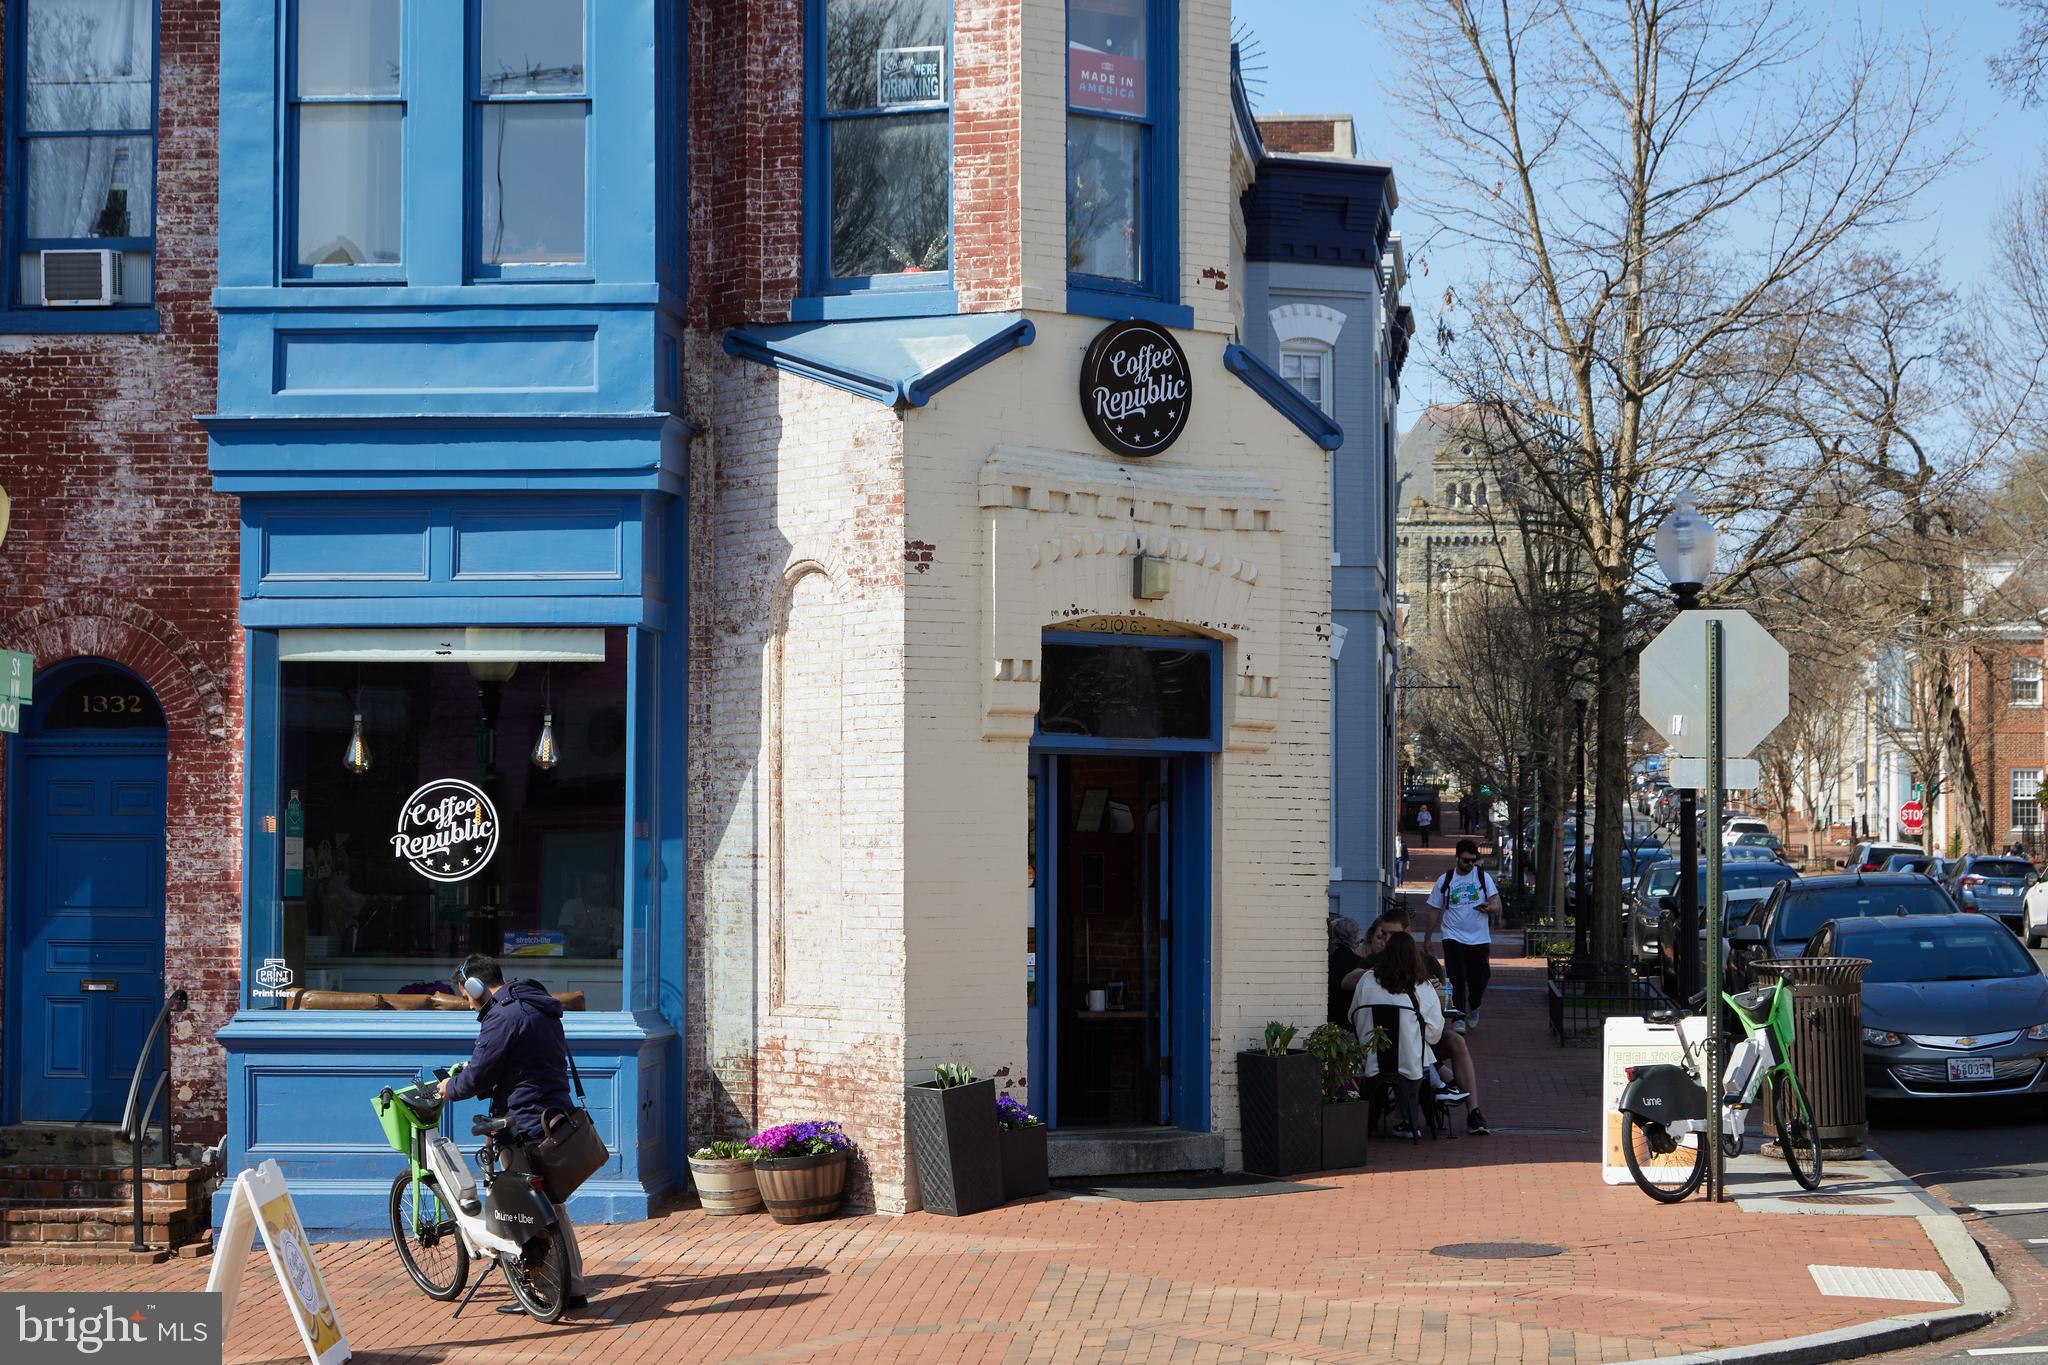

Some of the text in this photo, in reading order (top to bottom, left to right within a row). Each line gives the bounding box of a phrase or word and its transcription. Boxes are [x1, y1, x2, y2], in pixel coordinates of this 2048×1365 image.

[914, 63, 938, 76] WE'RE
[1081, 70, 1134, 87] MADE IN
[882, 77, 939, 98] DRINKING
[1079, 83, 1136, 99] AMERICA
[1110, 343, 1175, 385] Coffee
[1092, 374, 1188, 420] Republic
[11, 657, 21, 677] St
[82, 695, 143, 713] 1332
[407, 796, 477, 830] Coffee
[390, 818, 494, 860] Republic
[260, 970, 289, 978] PRINT
[252, 989, 296, 998] Print Here
[1614, 1051, 1683, 1065] FEELING
[1642, 1097, 1663, 1107] Lime
[500, 1211, 513, 1222] Lime
[518, 1213, 534, 1224] Uber
